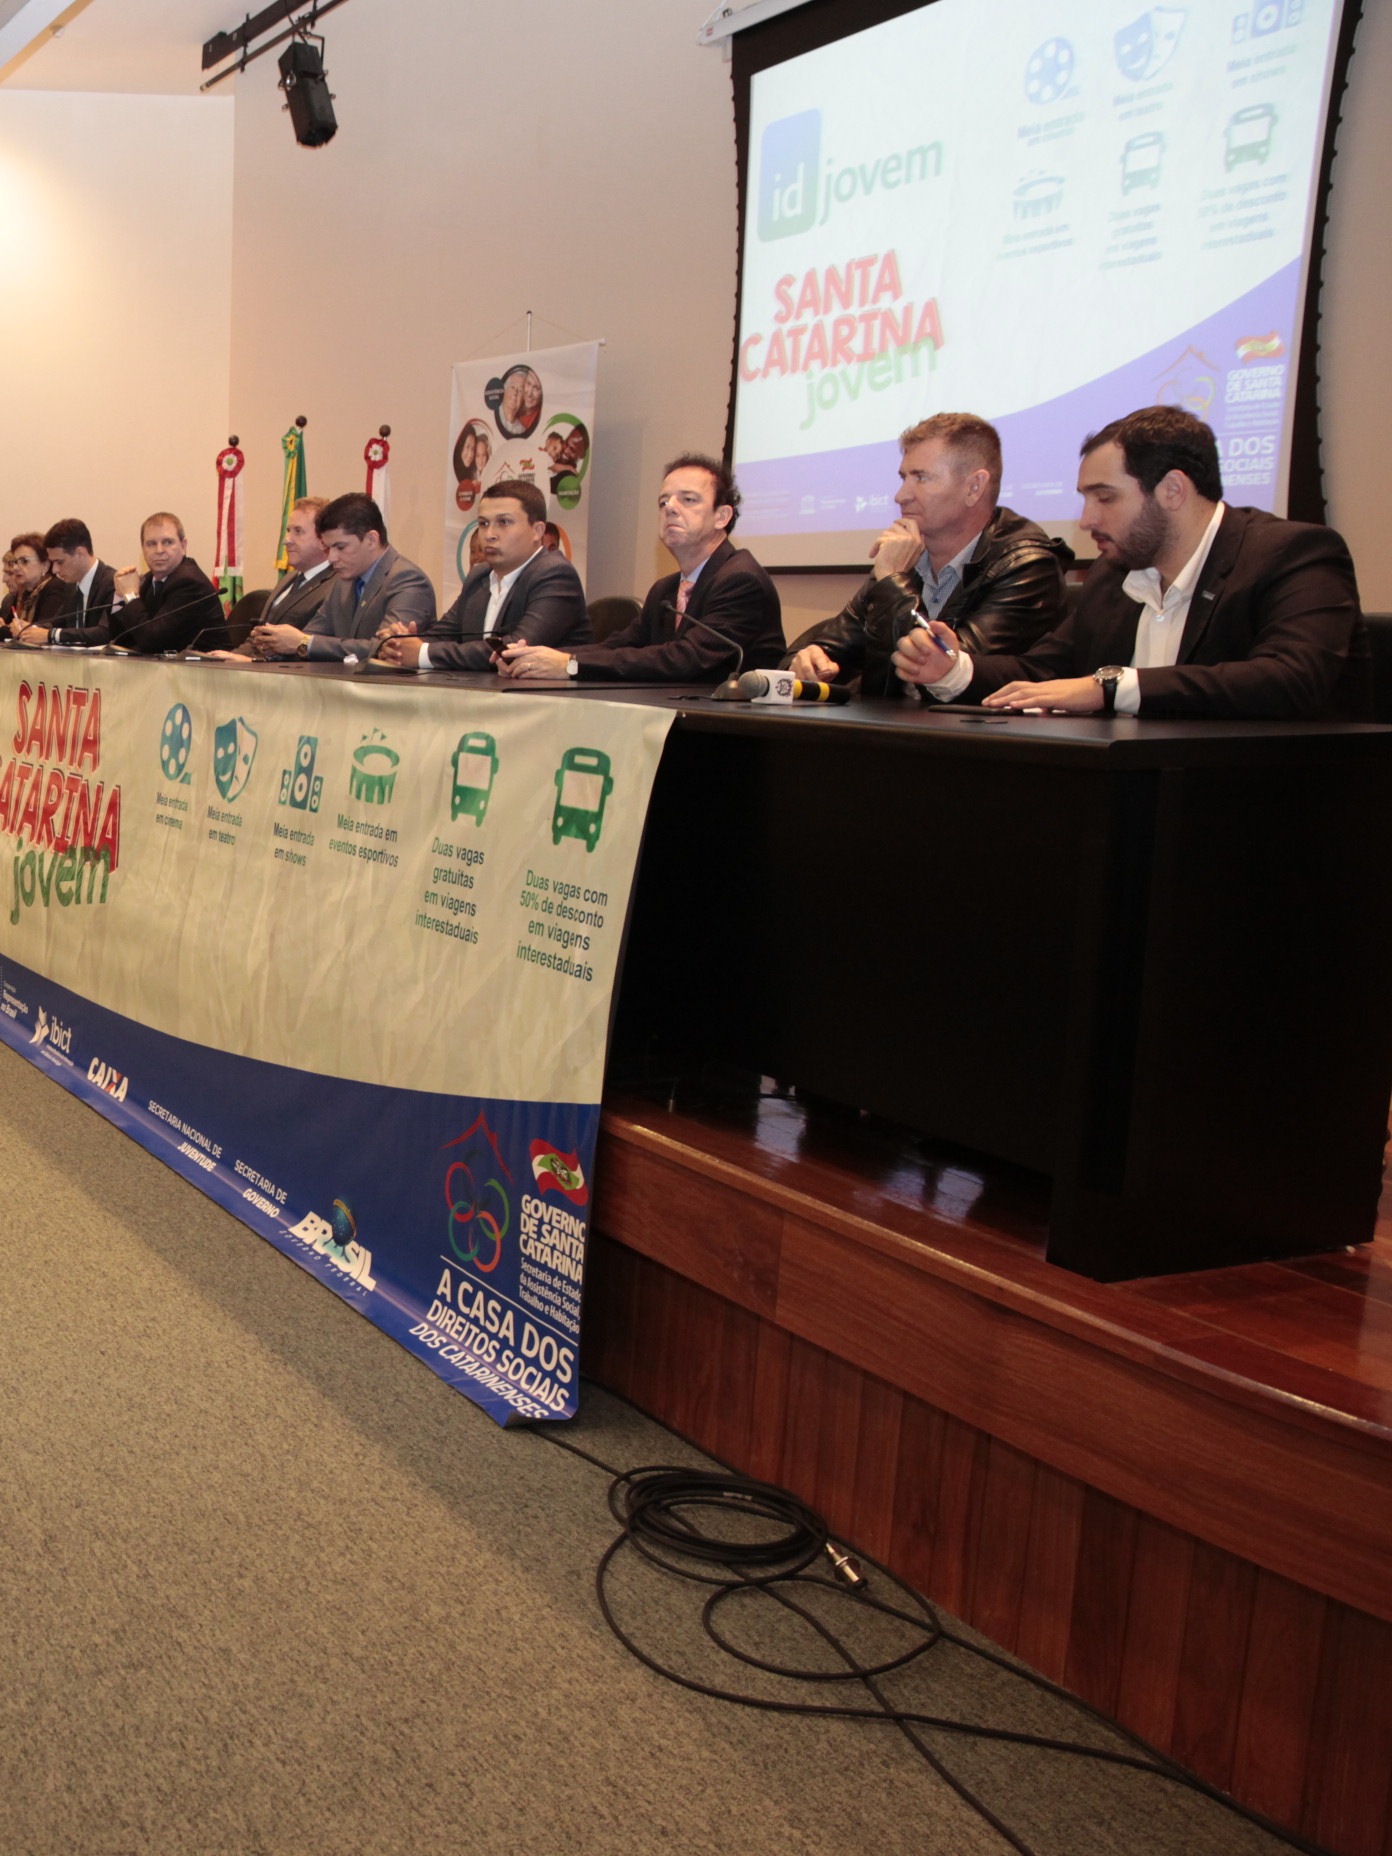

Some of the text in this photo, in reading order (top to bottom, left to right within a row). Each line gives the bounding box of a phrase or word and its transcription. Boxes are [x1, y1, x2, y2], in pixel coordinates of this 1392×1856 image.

[819, 139, 945, 227] jovem
[772, 248, 903, 324] SANTA
[739, 297, 945, 382] CATARINA
[798, 336, 938, 431] jovem
[1226, 375, 1283, 392] DE SANTA
[1227, 364, 1285, 380] GOVERNO
[1224, 387, 1281, 403] CATARINA
[1229, 435, 1276, 456] DOS
[12, 680, 101, 774] SANTA
[207, 805, 242, 827] Meia entrada
[273, 822, 315, 846] Meia entrada
[337, 813, 398, 843] Meia entrada em
[209, 829, 236, 845] em teatro
[328, 838, 399, 868] eventos esportivos
[431, 837, 485, 867] Duas vagas
[274, 847, 307, 867] em shows
[10, 837, 111, 926] jovem
[432, 867, 474, 889] gratuitas
[526, 869, 608, 907] Duas vagas com
[424, 890, 477, 917] em viagens
[520, 890, 604, 929] 50% de desconto
[415, 909, 479, 945] interestaduais
[528, 920, 591, 951] em viagens
[516, 940, 593, 982] interestaduais
[49, 1015, 72, 1054] ibict
[87, 1057, 129, 1103] CAIXA
[148, 1100, 223, 1159] SECRETARIA NACIONAL DE
[177, 1141, 217, 1172] JUVENTUDE
[233, 1159, 288, 1205] SECRETARIA DE
[242, 1188, 280, 1218] GOVERNO
[288, 1211, 377, 1292] BRASIL
[520, 1212, 584, 1264] DE SANTA
[519, 1234, 583, 1285] CATARINA
[520, 1257, 552, 1285] Secretaria
[552, 1275, 562, 1290] de
[519, 1272, 527, 1285] da
[526, 1277, 561, 1306] Assistência
[436, 1268, 575, 1384] A CASA DOS
[518, 1286, 580, 1335] Trabalho e Habitação
[409, 1322, 447, 1349] DOS
[426, 1299, 570, 1411] DIREITOS SOCIAIS
